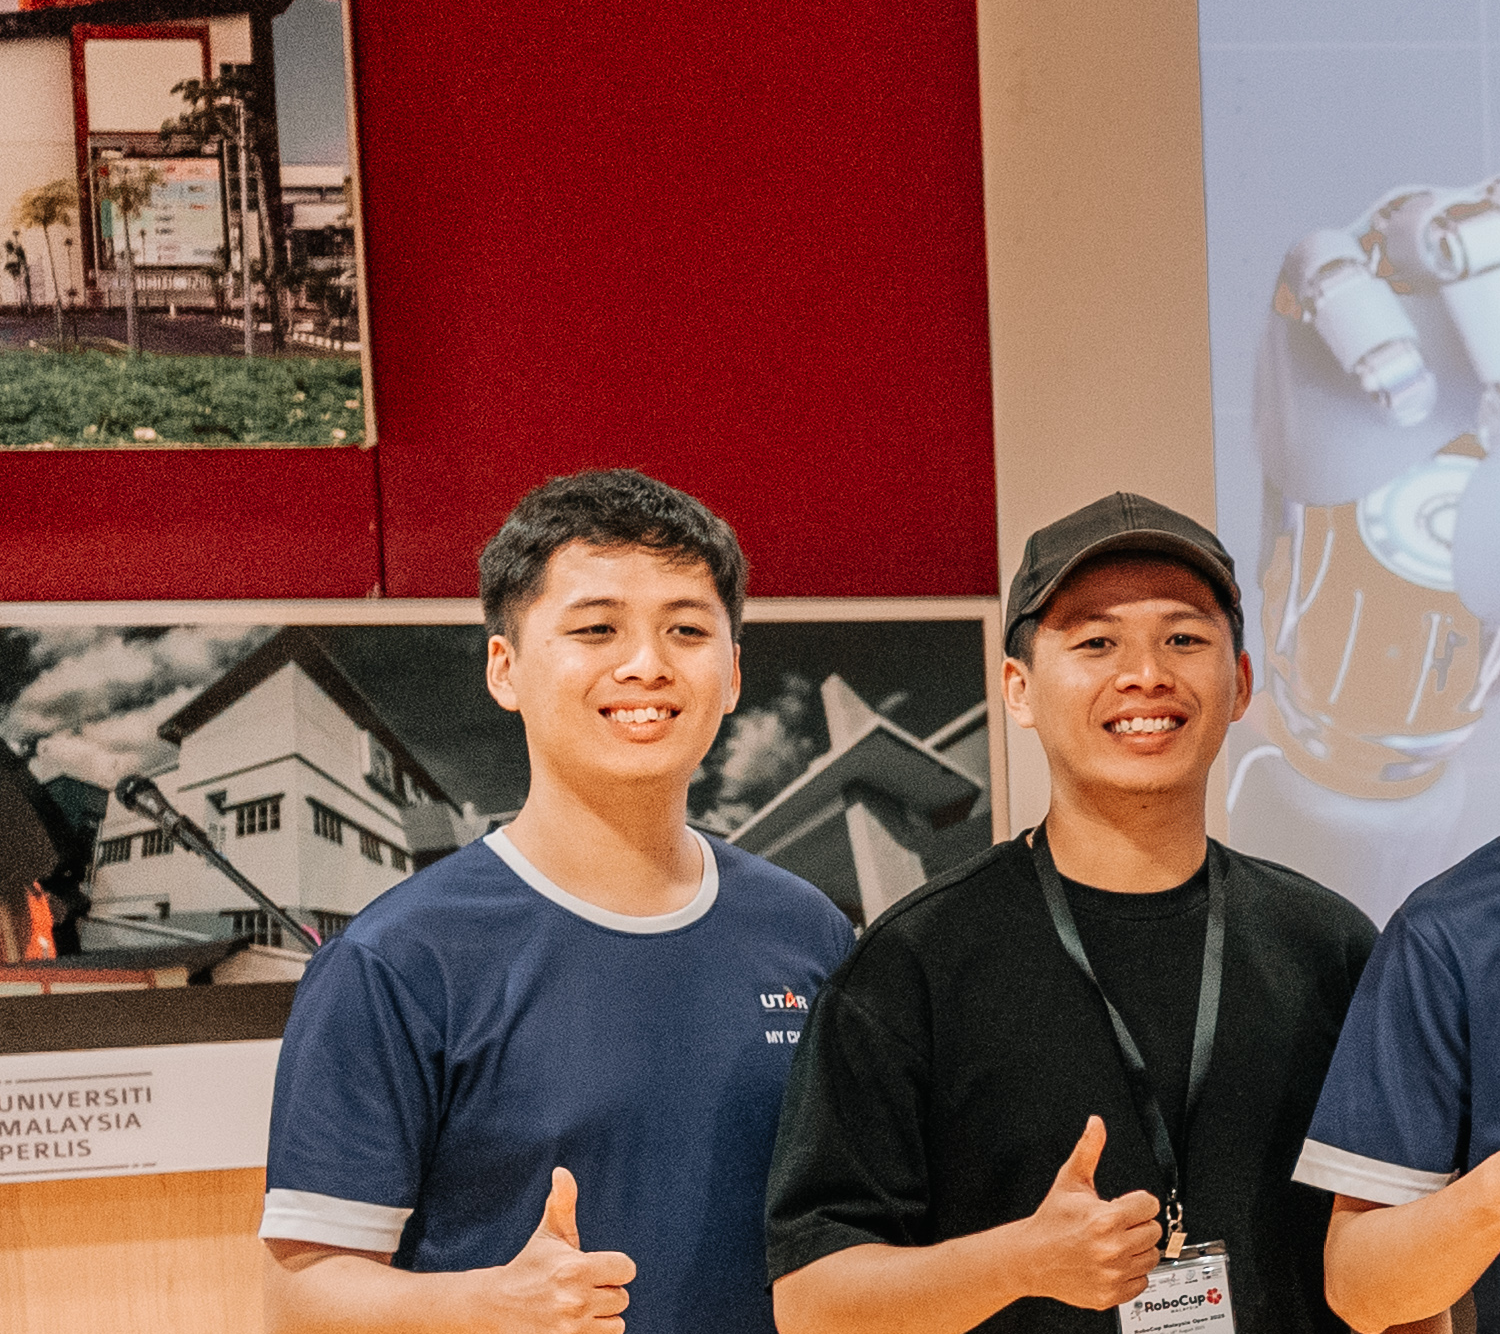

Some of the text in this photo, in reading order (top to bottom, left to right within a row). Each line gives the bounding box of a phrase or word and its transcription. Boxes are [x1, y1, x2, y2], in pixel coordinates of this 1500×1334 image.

[760, 991, 808, 1010] UTAR
[765, 1030, 784, 1044] MY
[0, 1086, 152, 1113] UNIVERSITI
[0, 1112, 142, 1137] MALAYSIA
[0, 1139, 92, 1161] PERLIS
[1145, 1294, 1205, 1313] RoboCup
